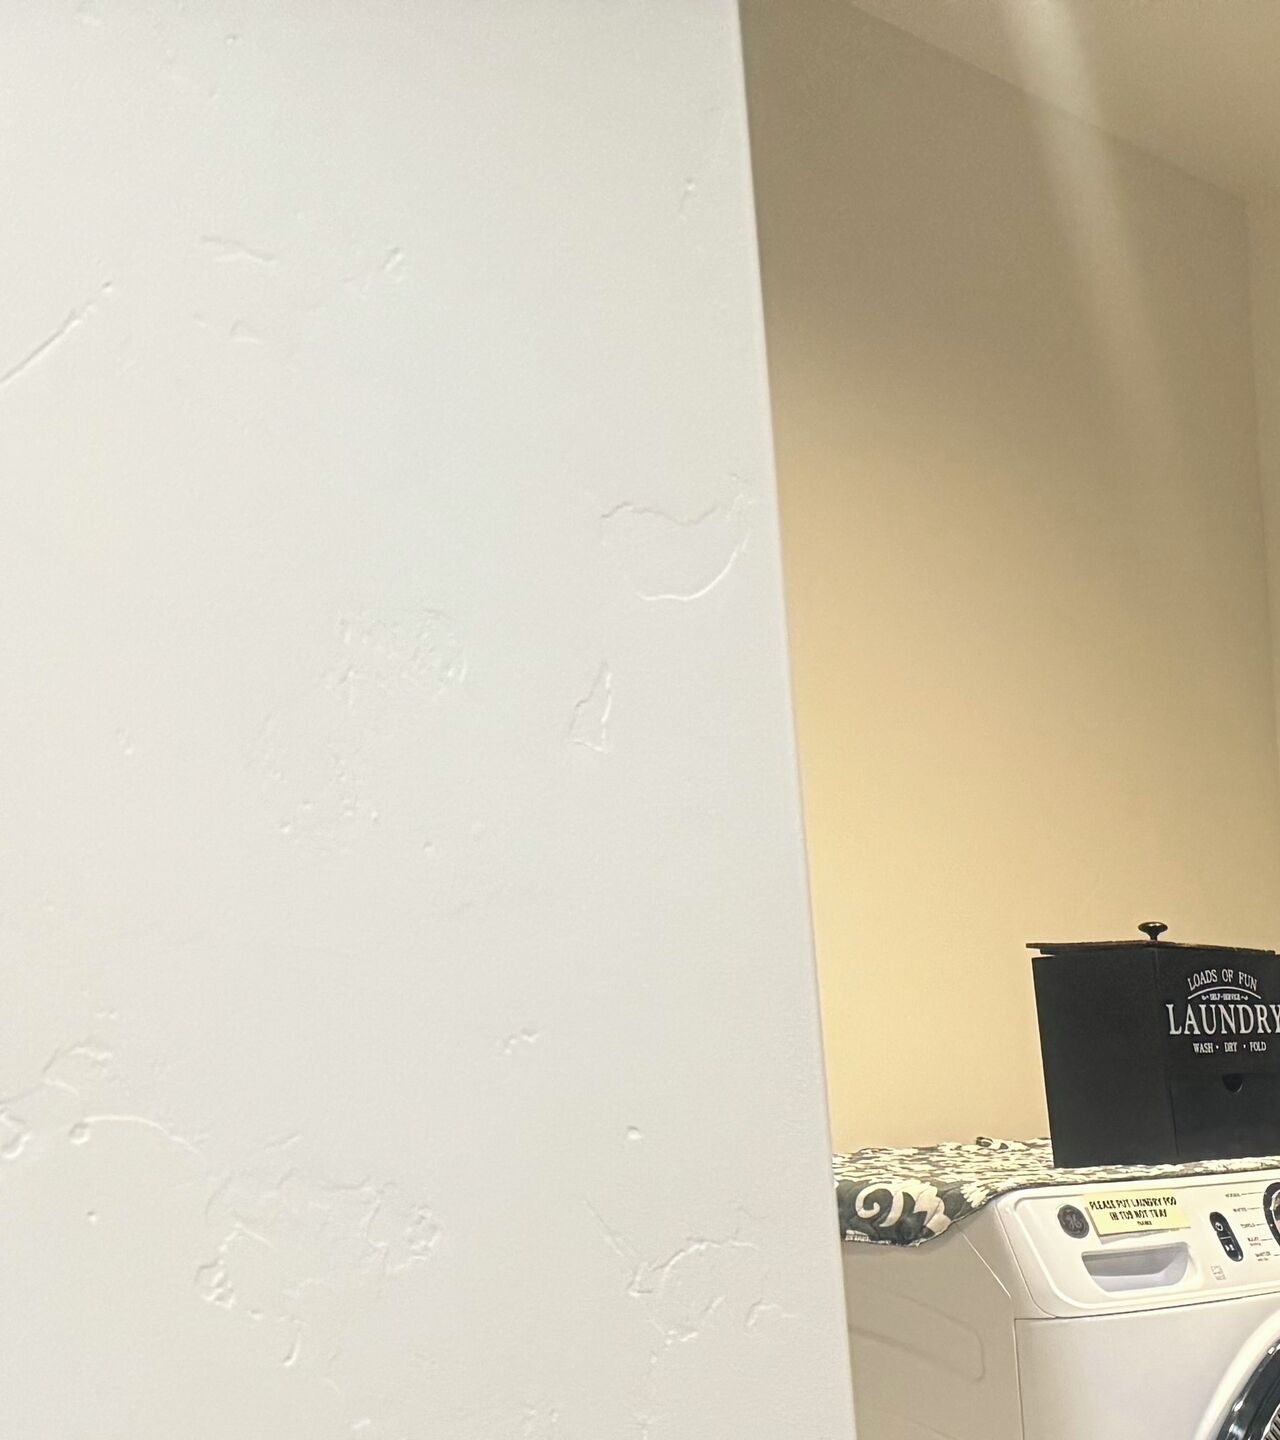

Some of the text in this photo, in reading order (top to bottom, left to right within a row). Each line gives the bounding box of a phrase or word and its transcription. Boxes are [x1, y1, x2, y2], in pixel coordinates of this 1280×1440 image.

[1187, 968, 1258, 991] LOADS OF FUN
[1193, 1041, 1267, 1054] WASH DRY FOLD
[1089, 1199, 1116, 1211] PLEASE
[1116, 1198, 1130, 1209] PUT
[1134, 1210, 1149, 1219] NOT
